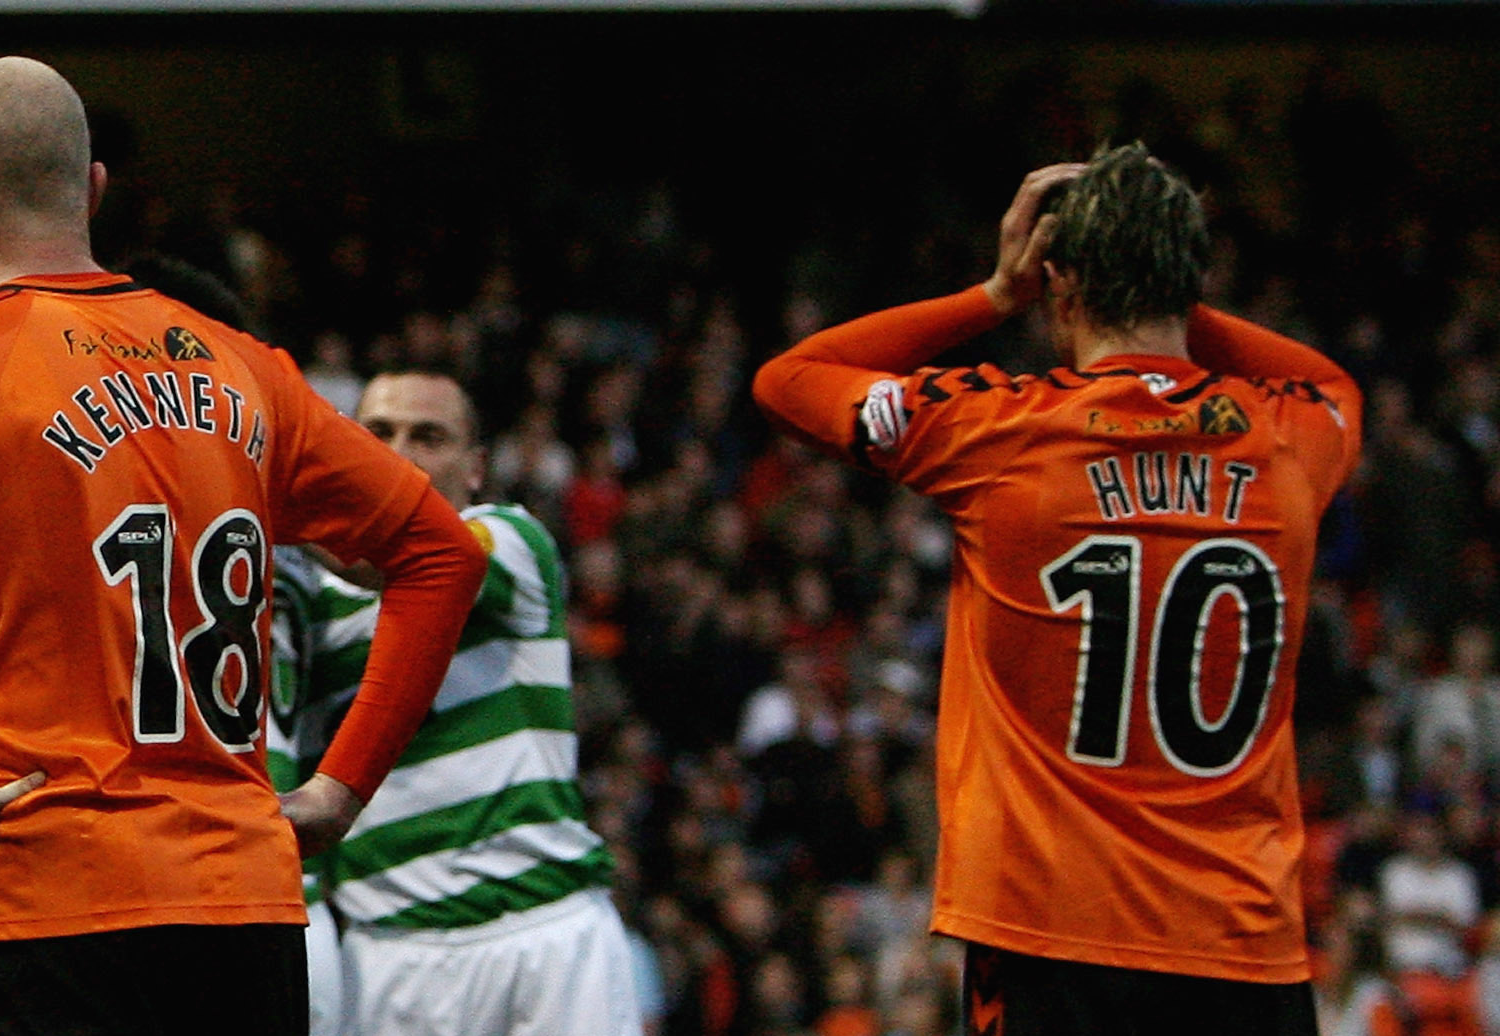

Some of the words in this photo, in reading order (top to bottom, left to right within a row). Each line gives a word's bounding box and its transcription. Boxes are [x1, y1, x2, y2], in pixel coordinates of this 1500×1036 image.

[42, 370, 267, 473] KENNETH
[1085, 452, 1256, 524] HUNT
[92, 503, 268, 753] 18
[1039, 534, 1285, 778] 10
